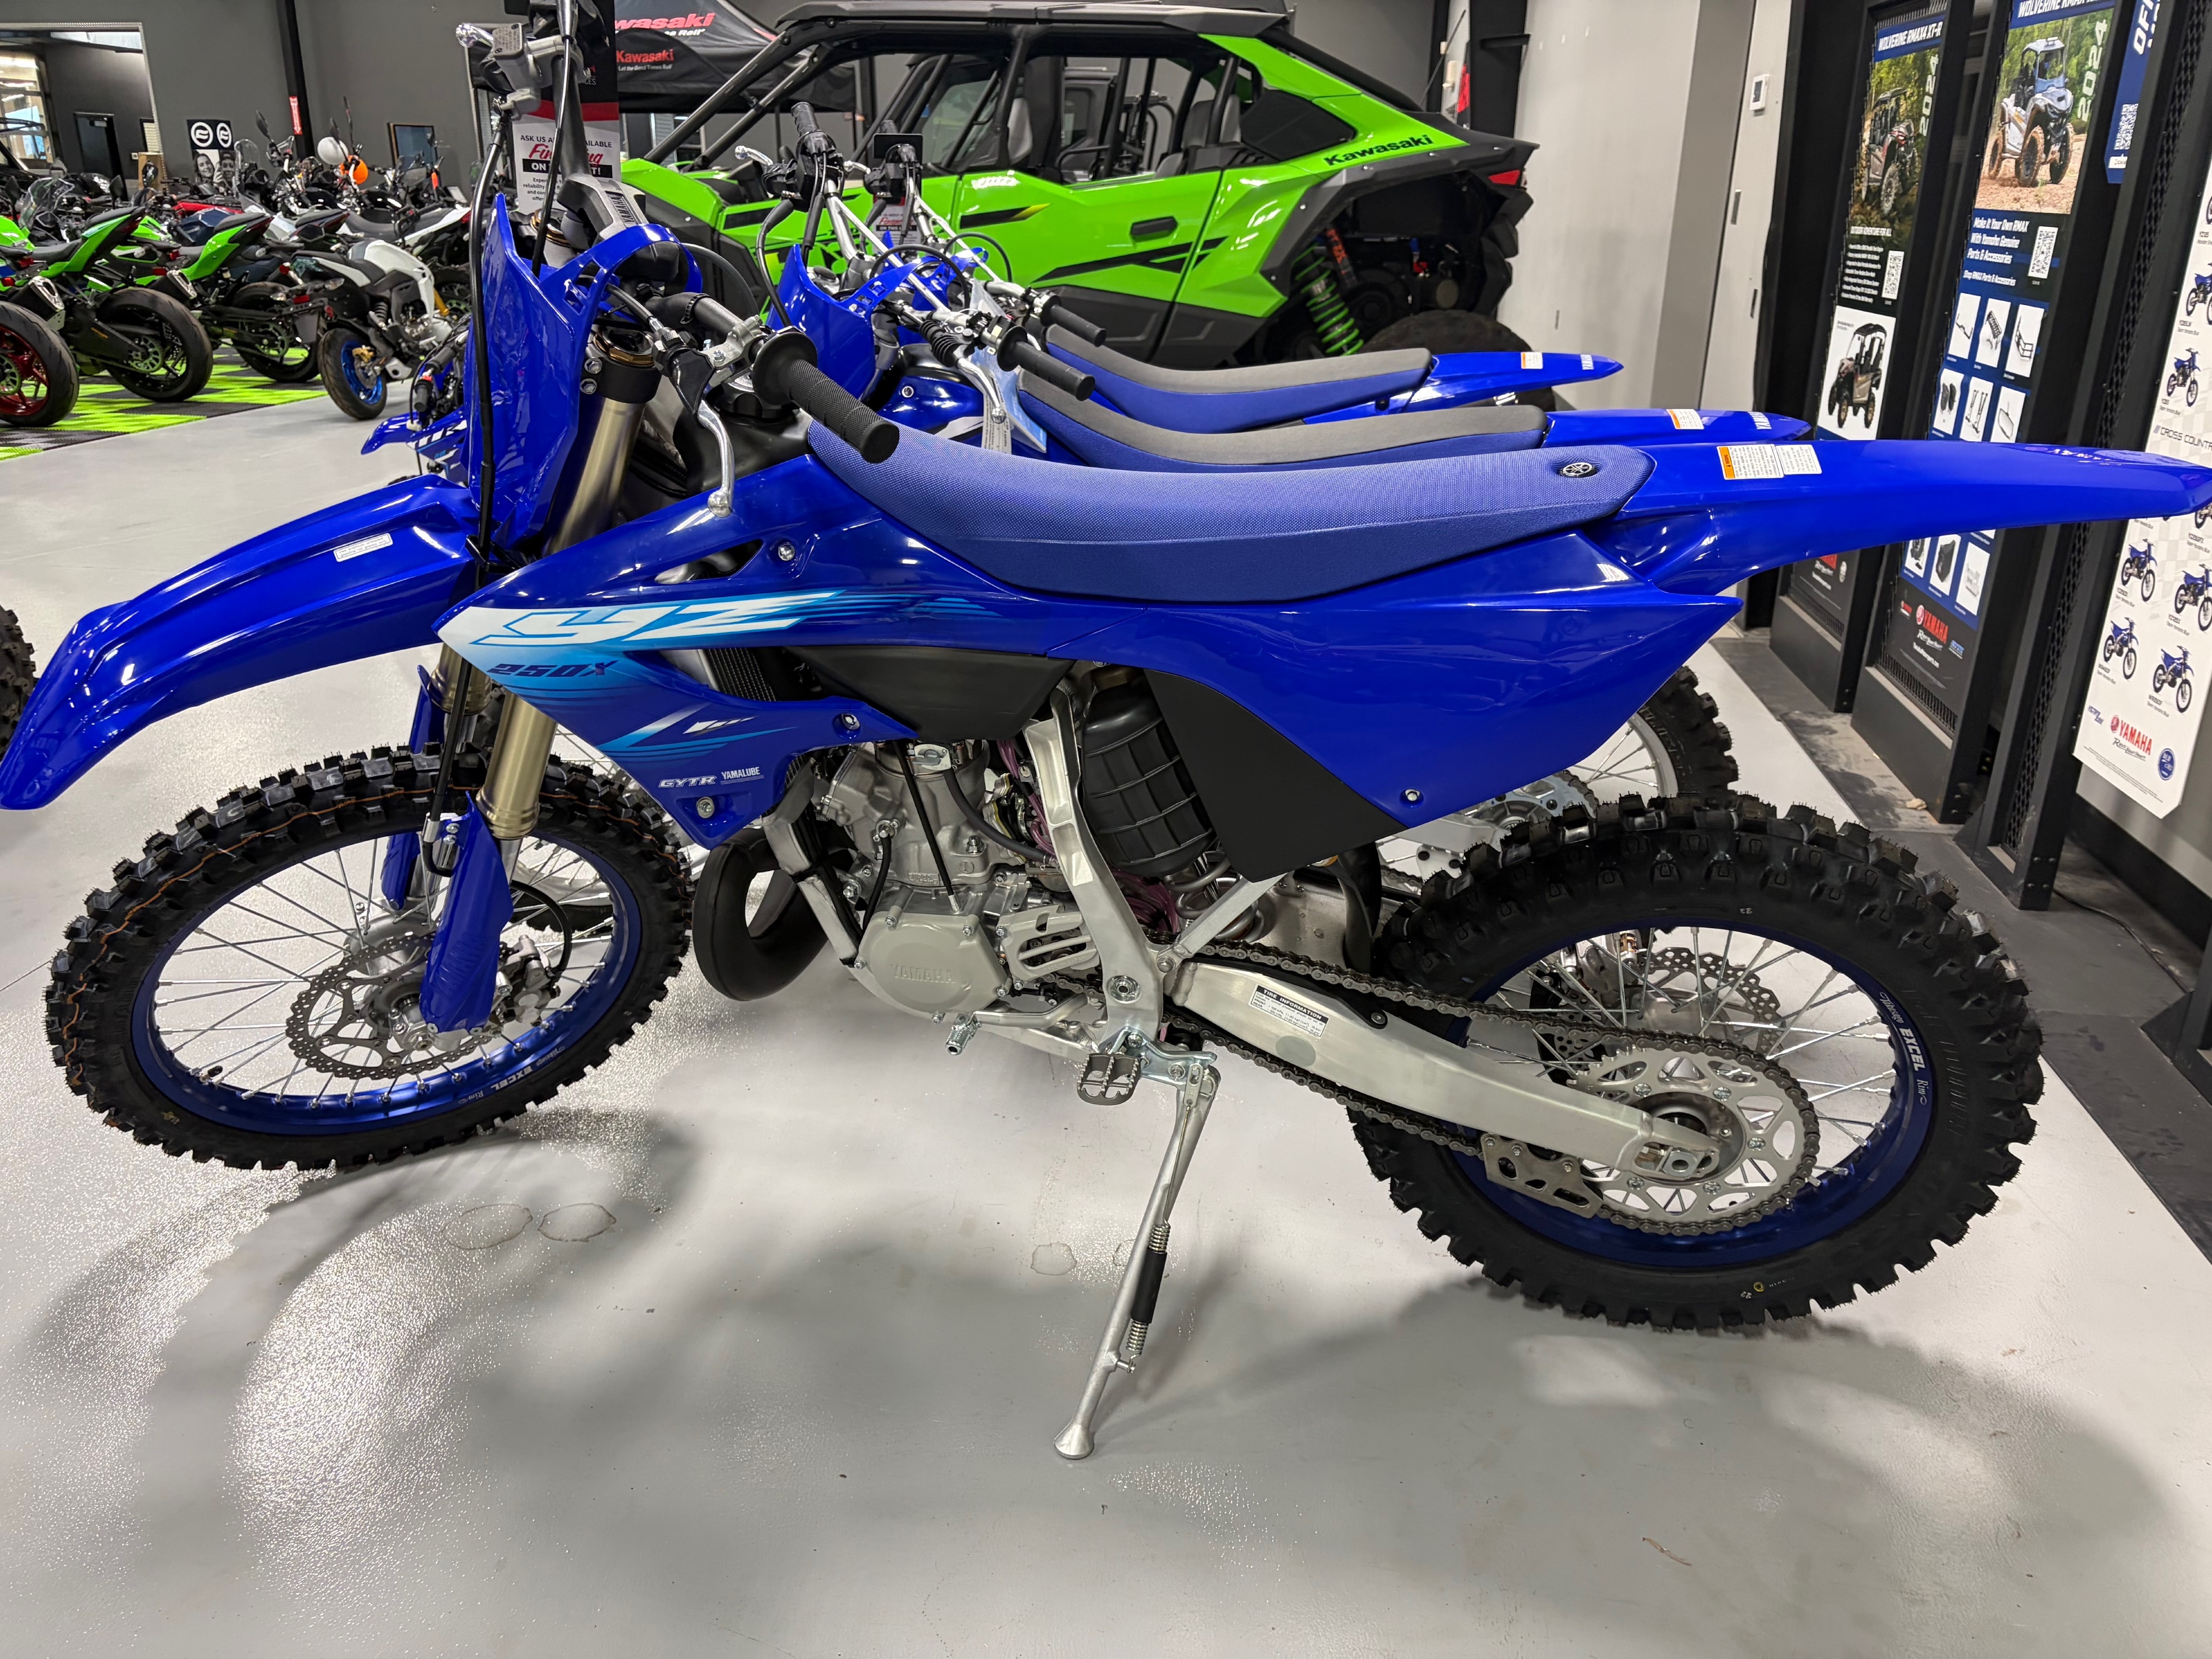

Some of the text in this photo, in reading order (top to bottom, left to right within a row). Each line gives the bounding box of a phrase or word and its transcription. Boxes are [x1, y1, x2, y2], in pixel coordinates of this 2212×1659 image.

[615, 13, 715, 29] wasaki
[1878, 22, 1943, 51] WOLVERINE RMAX4 XT-R
[616, 48, 674, 63] Kawasaki
[2078, 19, 2108, 122] 2024
[1919, 54, 1939, 136] 2024
[1324, 135, 1434, 167] Kawasaki
[531, 162, 546, 171] ON
[610, 196, 635, 222] YAMAHA
[1973, 217, 1987, 229] Make
[1990, 218, 2002, 230] Your
[2001, 219, 2012, 231] Own
[2013, 220, 2030, 233] RMAX
[1967, 248, 1980, 260] Parts
[1984, 250, 2013, 264] Accessories
[1748, 411, 1772, 429] YAMAHA
[2160, 427, 2212, 451] CROSS COUNTR
[1923, 609, 1949, 645] YAMAHA
[486, 659, 620, 678] 250X
[2119, 720, 2153, 756] YAMAHA
[659, 767, 761, 788] GYTR YAMALUBE
[890, 964, 956, 983] YAMAHA
[1263, 989, 1322, 1020] TIRE INFORMATION
[1879, 991, 1905, 1024] Takasago
[1899, 1027, 1925, 1071] EXCEL
[491, 1066, 534, 1091] EXCEL
[1916, 1078, 1929, 1105] Rim
